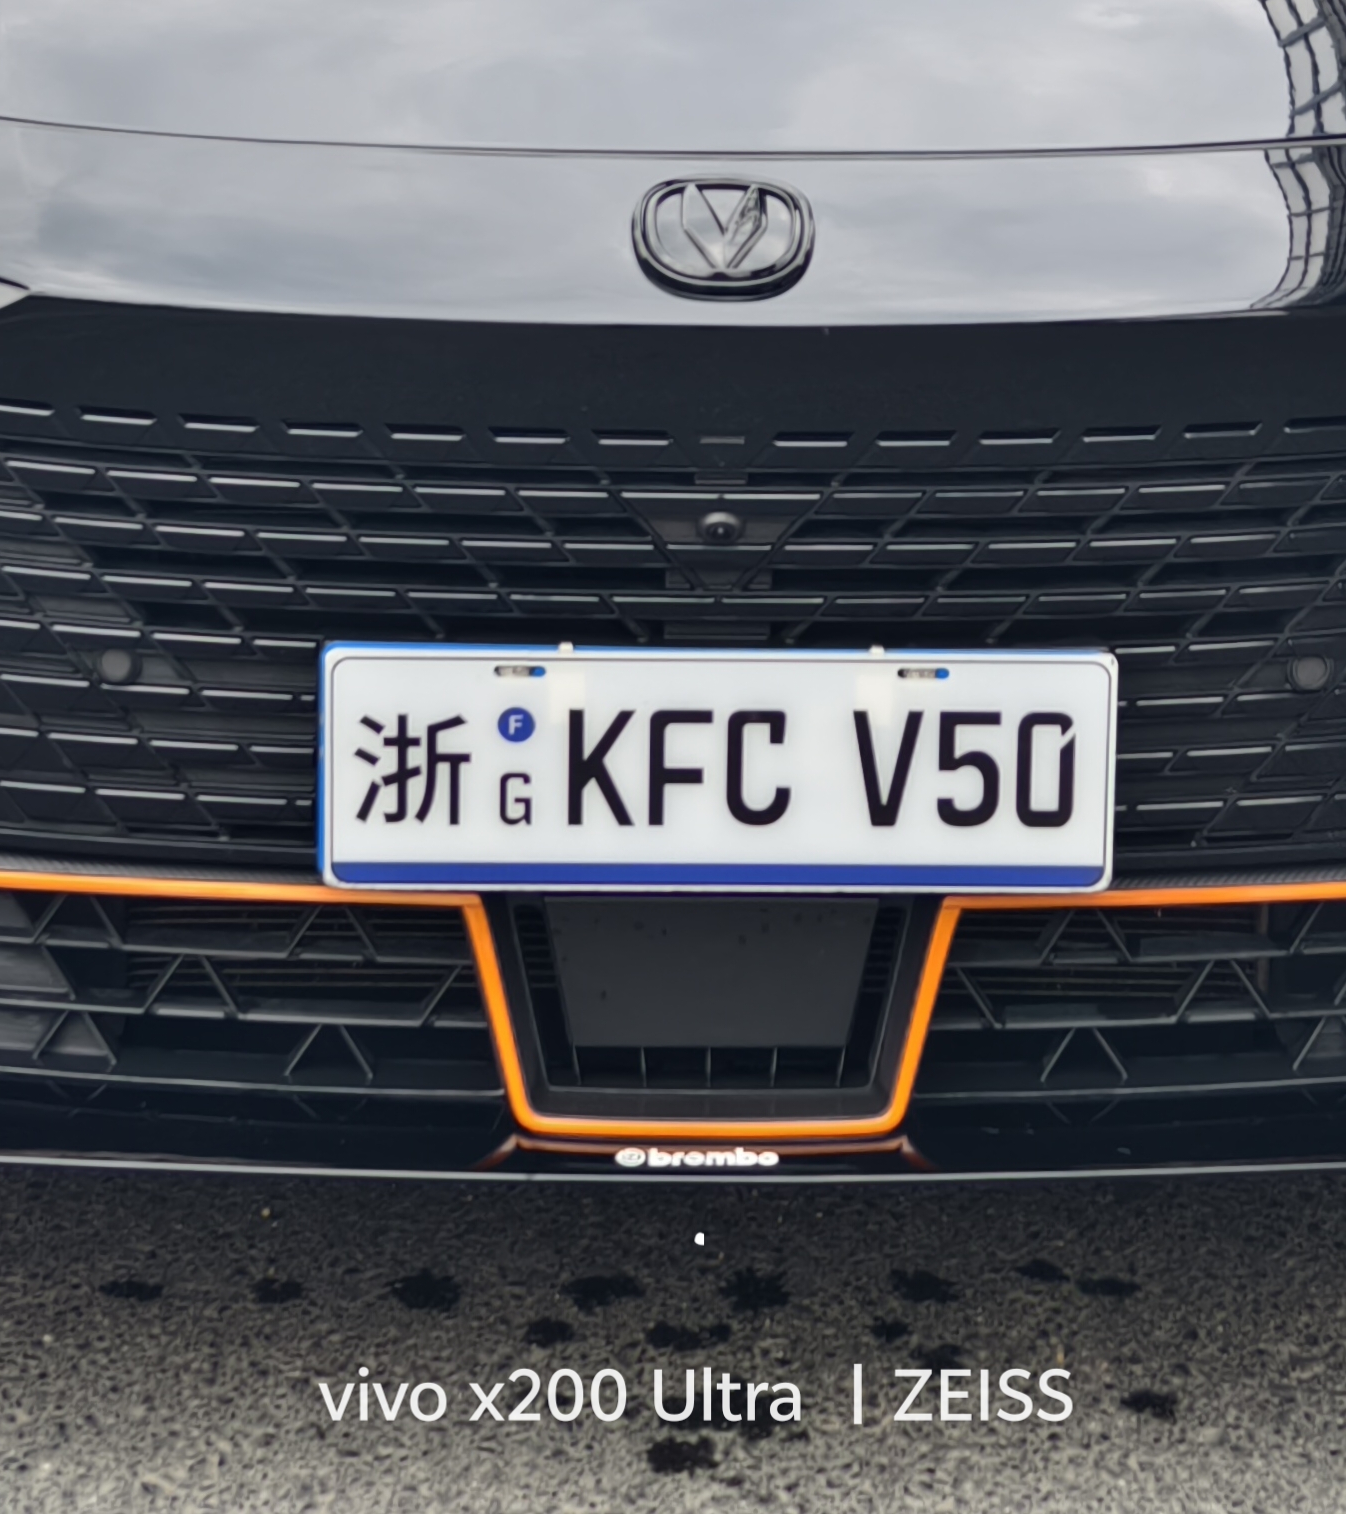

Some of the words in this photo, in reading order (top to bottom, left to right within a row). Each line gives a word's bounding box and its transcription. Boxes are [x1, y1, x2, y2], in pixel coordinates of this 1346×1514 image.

[508, 714, 524, 735] F
[354, 713, 471, 826] 浙
[499, 772, 532, 826] G
[567, 709, 791, 827] KFC
[853, 709, 1077, 828] V50
[648, 1147, 779, 1167] brembo
